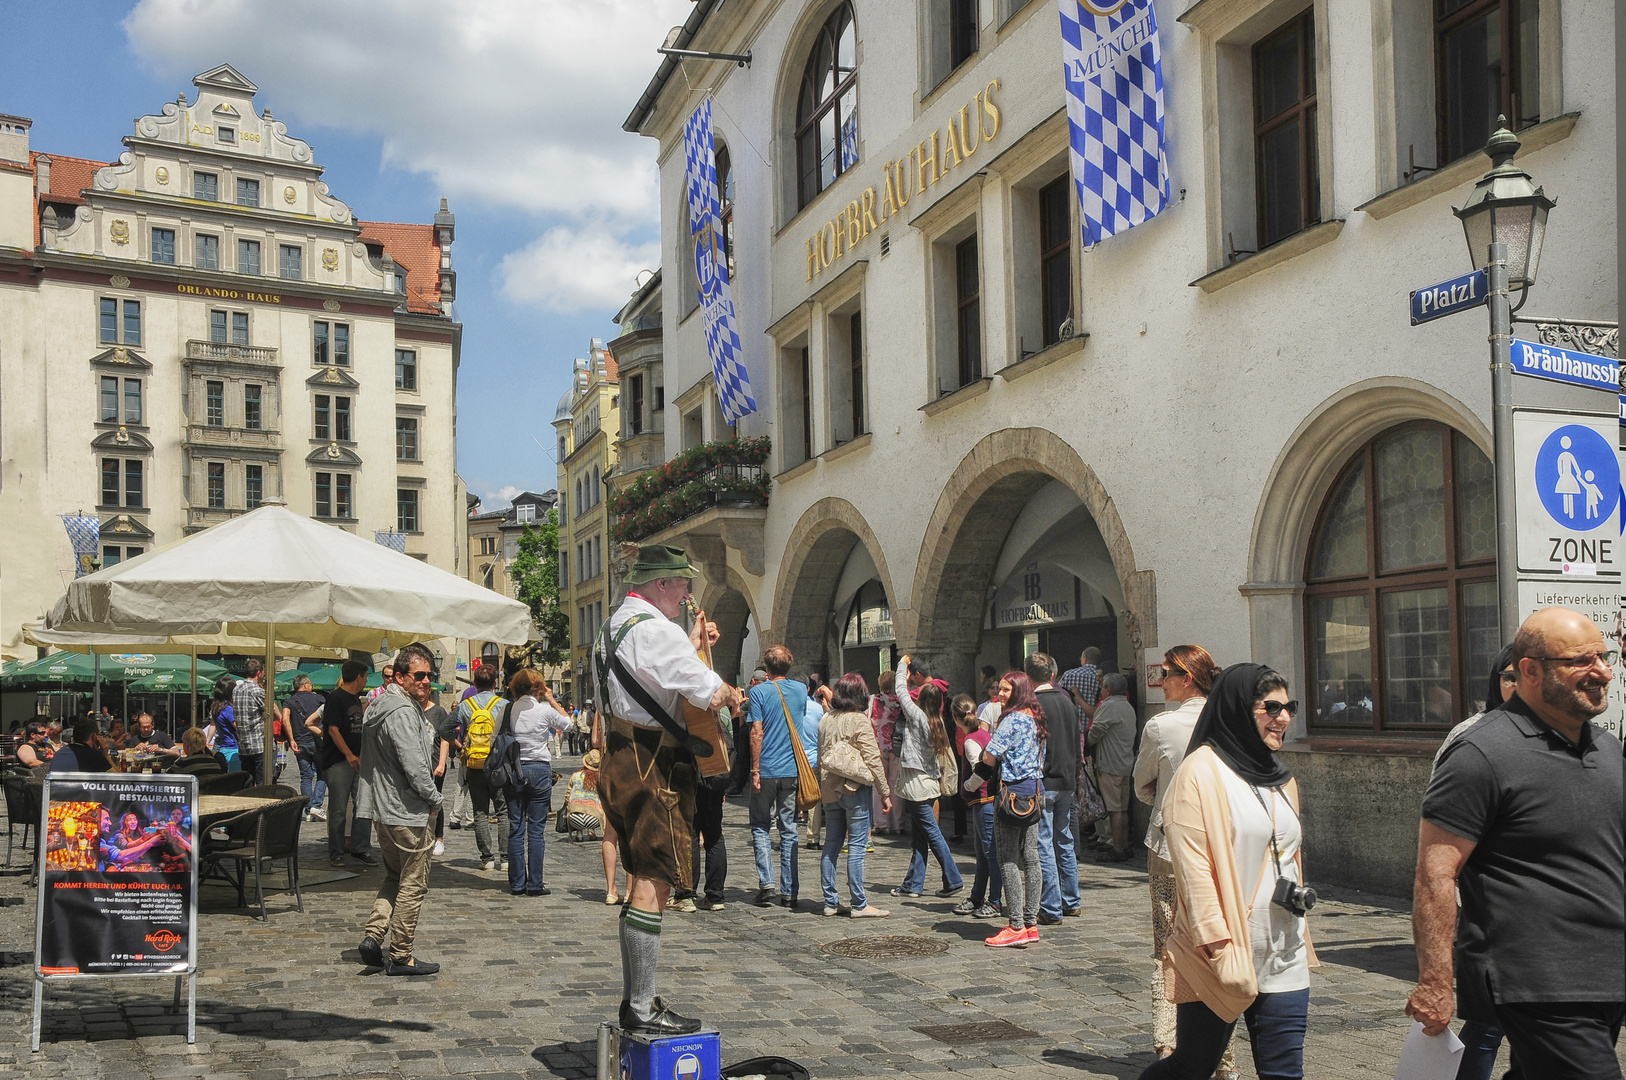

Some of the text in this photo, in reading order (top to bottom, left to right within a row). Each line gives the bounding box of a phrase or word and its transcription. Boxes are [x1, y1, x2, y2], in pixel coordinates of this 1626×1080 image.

[239, 131, 261, 143] 1899
[805, 78, 1000, 284] HOFBRÄUHAUS
[177, 284, 280, 304] ORLANDO HAUS
[1420, 275, 1476, 314] Platzl
[1548, 537, 1613, 564] ZONE
[1536, 592, 1610, 605] Lieferverkehr
[1592, 611, 1608, 622] bis
[124, 667, 155, 676] Ayinger
[82, 782, 186, 794] VOLL KLIMATISIERTES
[119, 793, 185, 804] RESTAURANT!
[128, 881, 150, 890] KÜHLT
[151, 882, 170, 890] EUCH
[144, 933, 182, 944] Hard Rock
[671, 1043, 703, 1053] MÜNCHEN
